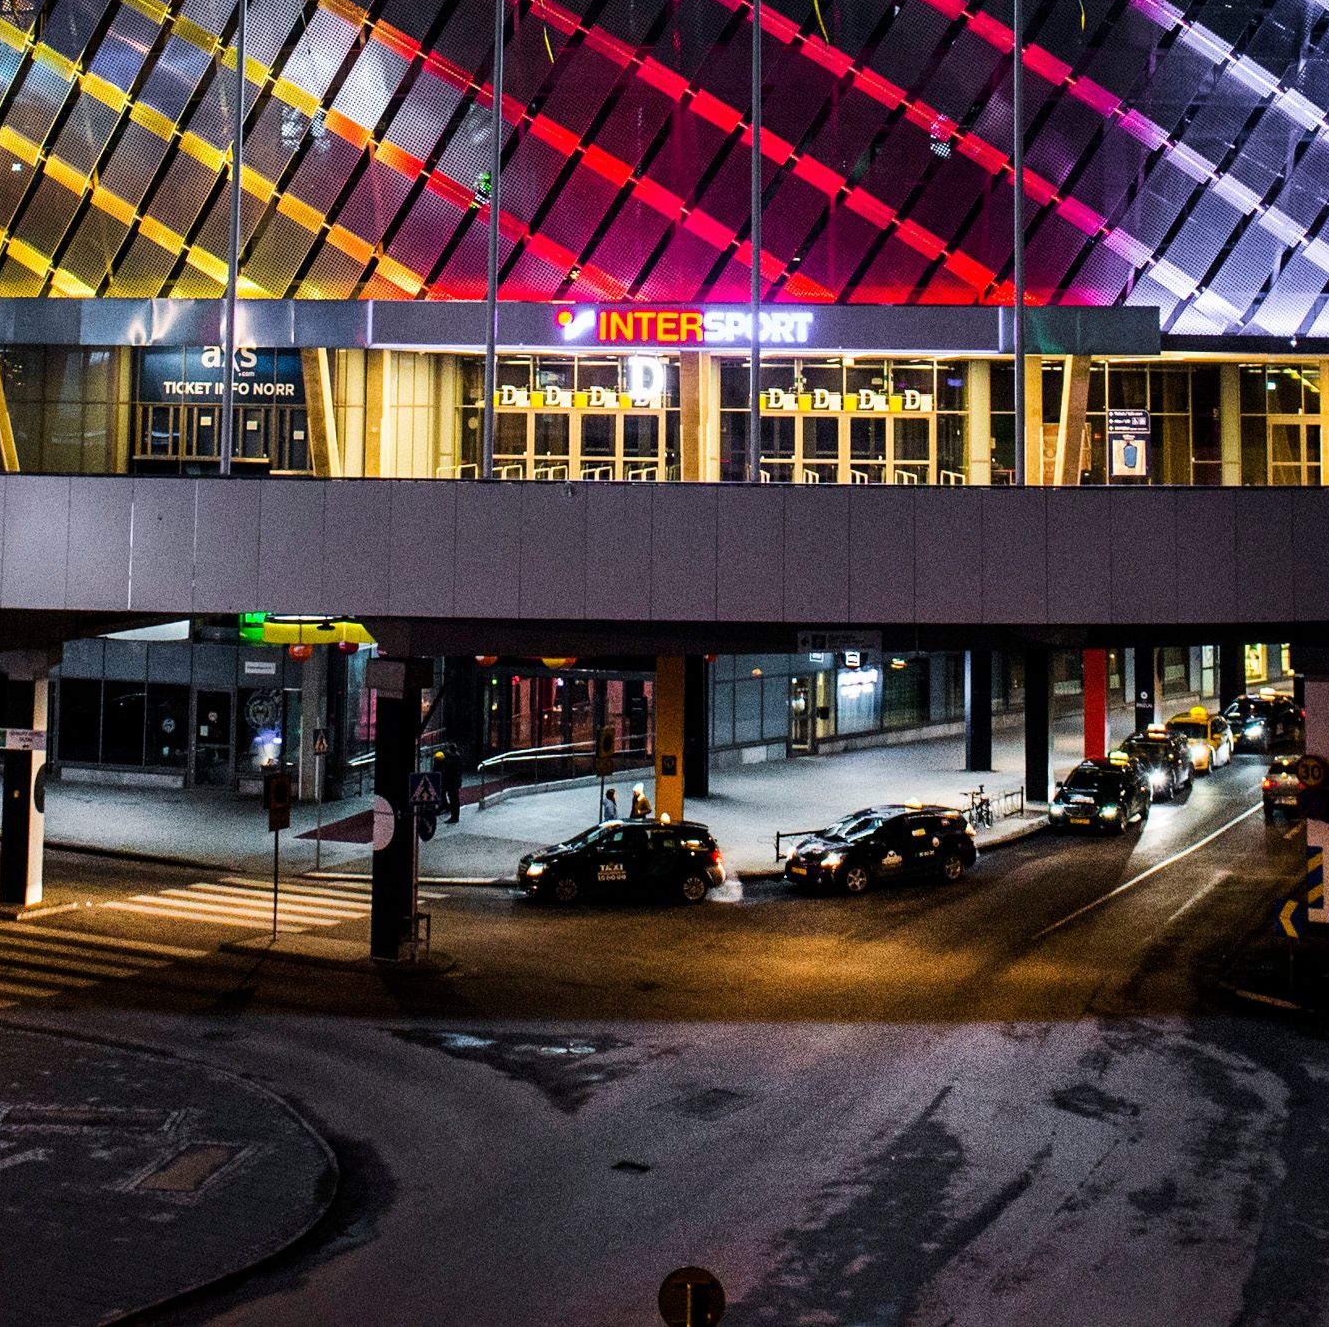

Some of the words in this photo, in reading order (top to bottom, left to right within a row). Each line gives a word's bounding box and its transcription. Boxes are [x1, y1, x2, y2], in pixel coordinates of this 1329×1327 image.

[599, 310, 814, 343] INTERSPORT
[628, 356, 664, 399] D
[163, 381, 212, 395] TICKET
[253, 383, 295, 396] NORR
[501, 385, 517, 405] D
[546, 386, 561, 405] D
[590, 386, 605, 406] D
[768, 388, 784, 408] D
[814, 389, 830, 409] D
[859, 389, 874, 409] D
[904, 390, 921, 410] D
[1301, 763, 1322, 781] 30
